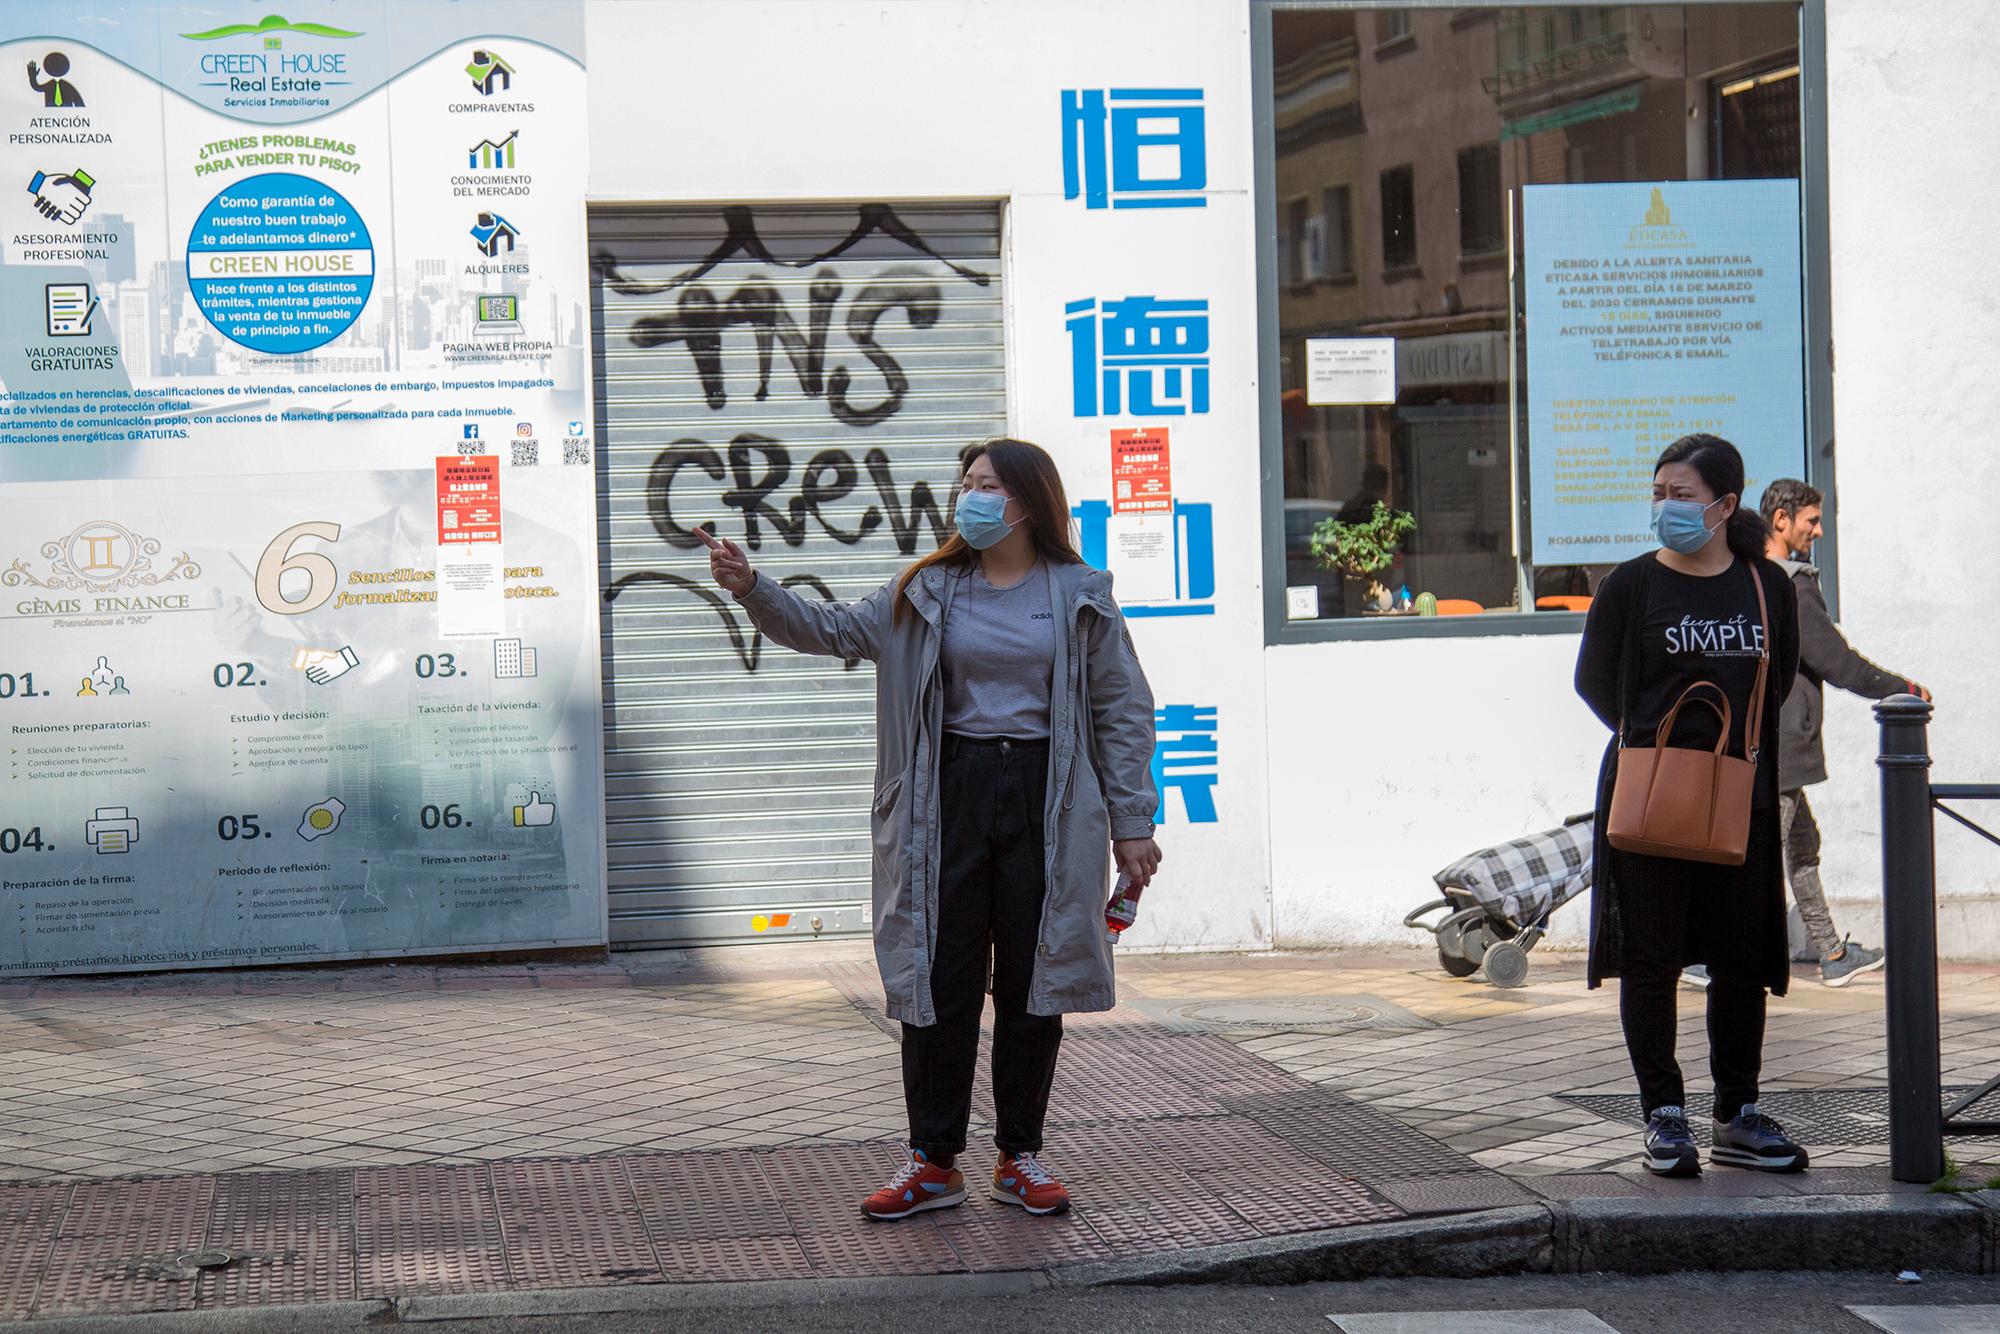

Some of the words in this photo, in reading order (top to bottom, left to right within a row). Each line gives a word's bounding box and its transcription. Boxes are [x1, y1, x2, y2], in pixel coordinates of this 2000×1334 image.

[281, 54, 346, 73] HOUSE
[230, 77, 266, 92] Real
[272, 76, 321, 92] Estate
[224, 98, 266, 106] Servicios
[270, 97, 330, 106] Inmobiliarios
[448, 104, 534, 112] COMPRAVENTAS
[30, 114, 90, 128] ATENCIÓN
[9, 133, 112, 144] PERSONALIZADA
[198, 136, 258, 160] ¿TIENES
[262, 135, 356, 156] PROBLEMAS
[194, 156, 234, 177] PARA
[236, 152, 294, 168] VENDER
[298, 153, 316, 166] TU
[318, 156, 361, 175] PISO?
[451, 175, 532, 185] CONOCIMIENTO
[454, 187, 474, 196] DEL
[477, 186, 530, 196] MERCADO
[220, 195, 258, 208] Como
[262, 194, 316, 210] garantía
[319, 194, 335, 206] de
[212, 214, 260, 226] nuestro
[265, 214, 297, 226] buen
[300, 213, 346, 228] trabajo
[13, 233, 118, 245] ASESORAMIENTO
[203, 234, 216, 245] te
[220, 232, 305, 244] adelantamos
[24, 250, 109, 260] PROFESIONAL
[1554, 258, 1600, 269] DEBIDO
[1602, 258, 1610, 268] A
[1614, 258, 1630, 268] LA
[1634, 256, 1682, 267] ALERTA
[1686, 255, 1752, 266] SANITARIA
[286, 255, 354, 272] HOUSE
[464, 264, 530, 274] ALQUILERES
[1602, 270, 1668, 281] SERVICIOS
[1670, 268, 1764, 280] INMOBILIARIOS
[207, 284, 236, 295] Hace
[240, 282, 274, 294] frente
[277, 285, 285, 294] a
[288, 282, 305, 294] los
[308, 281, 357, 292] distintos
[202, 297, 254, 310] trámites,
[258, 296, 310, 307] mientras
[313, 295, 362, 309] gestiona
[1562, 299, 1586, 309] DEL
[1624, 296, 1694, 306] CERRAMOS
[1698, 295, 1756, 305] DURANTE
[214, 311, 225, 322] la
[228, 311, 260, 321] venta
[264, 310, 278, 321] de
[282, 310, 294, 320] tu
[233, 325, 246, 336] de
[251, 324, 300, 338] principio
[304, 326, 312, 334] a
[314, 323, 332, 334] fin.
[1560, 326, 1614, 336] ACTIVOS
[1617, 324, 1682, 334] MEDIANTE
[1686, 322, 1743, 332] SERVICIO
[1746, 322, 1763, 331] DE
[443, 342, 482, 352] PAGINA
[486, 342, 510, 352] WEB
[513, 341, 552, 350] PROPIA
[1592, 337, 1680, 348] TELETRABAJO
[1683, 336, 1708, 346] POR
[1712, 332, 1732, 345] VÍA
[25, 346, 118, 358] VALORACIONES
[31, 358, 114, 371] GRATUITAS
[60, 392, 73, 400] en
[76, 388, 131, 400] herencias,
[134, 386, 225, 398] descalificaciones
[228, 386, 241, 396] de
[244, 384, 294, 396] viviendas,
[298, 382, 372, 394] cancelaciones
[374, 382, 388, 392] de
[390, 380, 440, 394] embargo,
[14, 405, 26, 414] de
[30, 404, 80, 414] viviendas
[84, 403, 97, 413] de
[100, 400, 156, 415] protección
[158, 400, 193, 411] oficial.
[60, 418, 74, 428] de
[77, 416, 150, 428] comunicación
[154, 415, 191, 428] propio,
[194, 416, 214, 424] con
[216, 414, 262, 424] acciones
[265, 412, 279, 422] de
[281, 410, 334, 422] Marketing
[336, 408, 408, 422] personalizada
[412, 408, 434, 420] para
[437, 406, 462, 418] cada
[62, 430, 124, 444] energéticas
[128, 429, 190, 440] GRATUITAS.
[255, 520, 341, 616] 6
[348, 568, 436, 585] Sencillos
[94, 594, 189, 612] FINANCE
[52, 618, 114, 628] Financiamos
[116, 616, 124, 626] el
[1680, 614, 1719, 634] keep
[1728, 614, 1747, 624] it
[1666, 625, 1764, 654] SIMPLE
[415, 653, 468, 679] 03.
[213, 662, 268, 688] 02.
[0, 672, 50, 698] 01.
[418, 704, 463, 714] Tasación
[466, 702, 478, 712] de
[482, 702, 491, 712] la
[494, 700, 542, 712] vivienda:
[230, 713, 270, 724] Estudio
[272, 714, 278, 722] y
[282, 710, 330, 721] decisión:
[12, 724, 70, 734] Reuniones
[73, 720, 151, 733] preparatorias:
[421, 804, 472, 830] 06.
[218, 814, 272, 841] 05.
[0, 827, 55, 854] 04.
[422, 856, 450, 865] Firma
[454, 856, 466, 864] en
[219, 866, 260, 876] Periodo
[264, 864, 277, 874] de
[280, 862, 330, 872] reflexión:
[4, 878, 70, 890] Preparación
[72, 876, 87, 886] de
[90, 876, 98, 884] la
[102, 874, 135, 884] firma:
